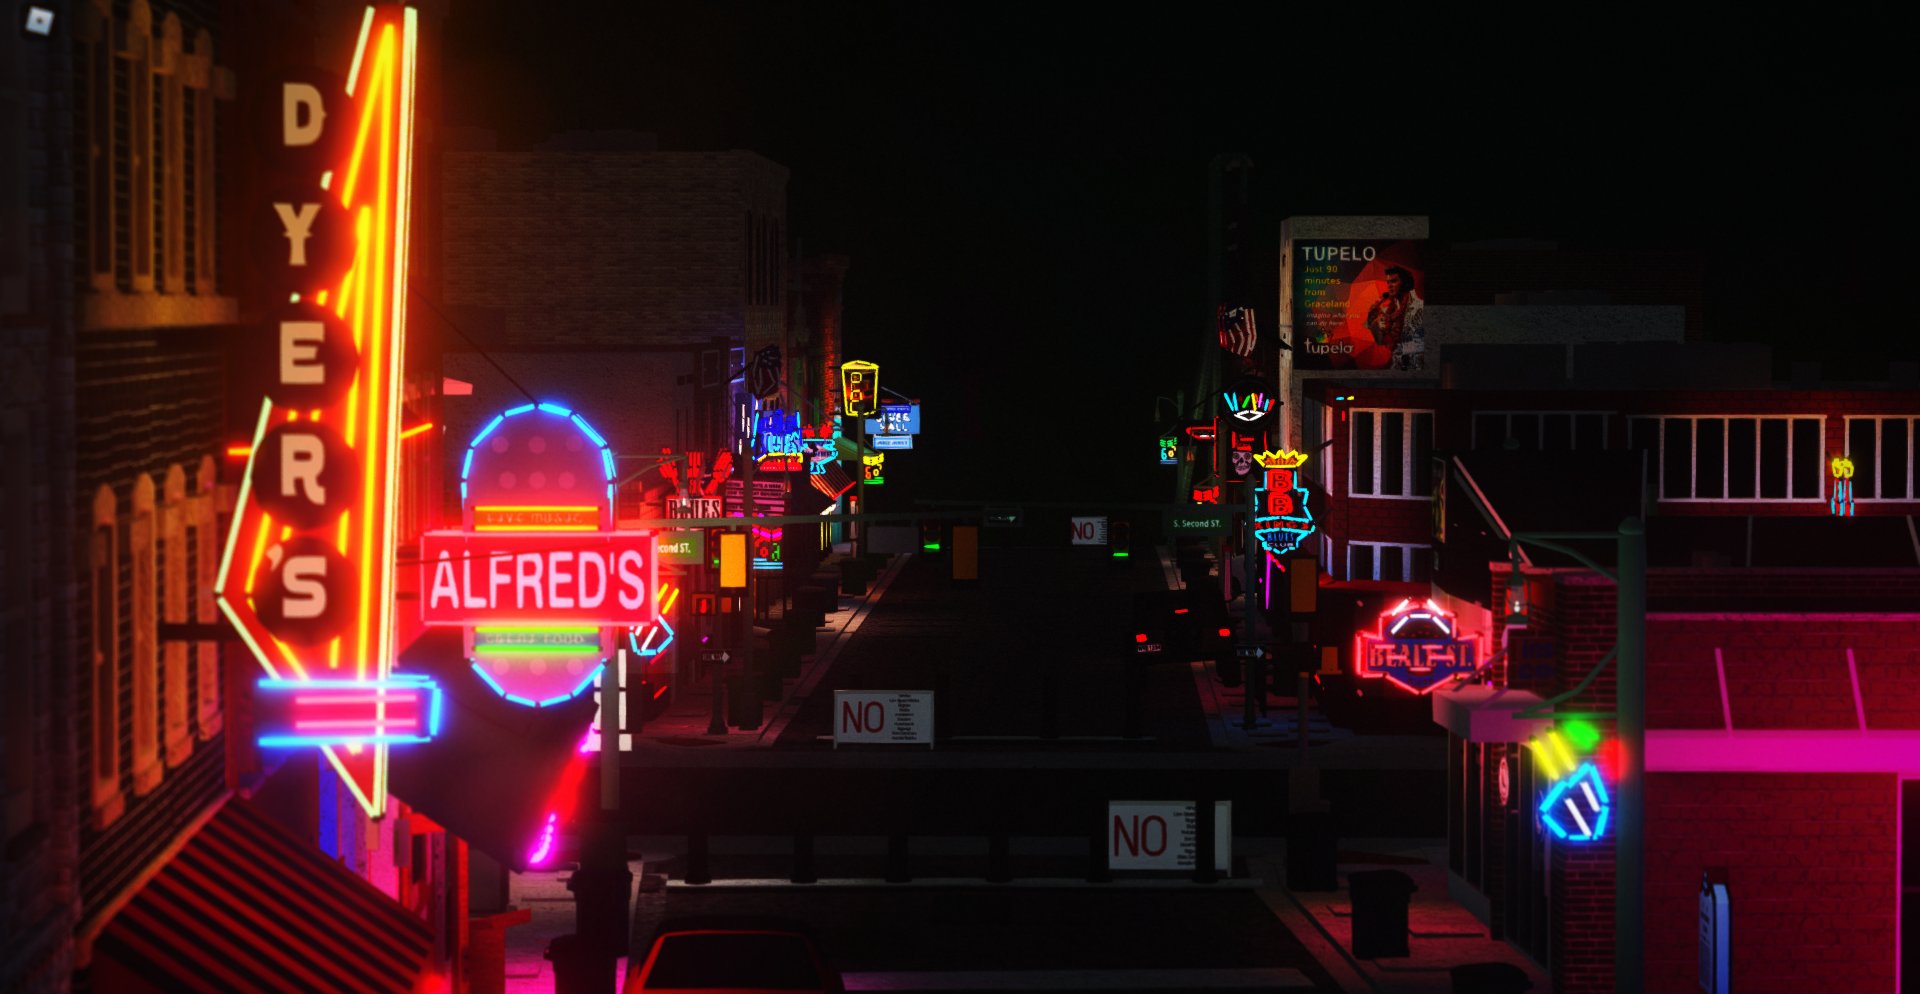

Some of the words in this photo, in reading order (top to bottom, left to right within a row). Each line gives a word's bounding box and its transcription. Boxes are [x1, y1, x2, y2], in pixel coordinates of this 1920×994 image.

[1302, 245, 1376, 262] TUPELO
[1304, 265, 1322, 273] Just
[1326, 265, 1338, 273] 90
[1304, 277, 1342, 285] minutes
[1304, 288, 1327, 296] from
[1304, 299, 1350, 308] Graceland
[1304, 338, 1354, 355] tupelo
[669, 500, 720, 519] BUES
[1072, 521, 1095, 540] NO
[1182, 519, 1209, 529] Second
[1210, 519, 1222, 529] ST.
[1267, 532, 1295, 542] BLUES
[679, 543, 692, 554] ST.
[430, 549, 646, 611] ALFRED'S
[1369, 643, 1437, 668] BEALE
[1445, 643, 1473, 668] ST.
[842, 700, 885, 734] NO
[1113, 815, 1168, 857] NO
